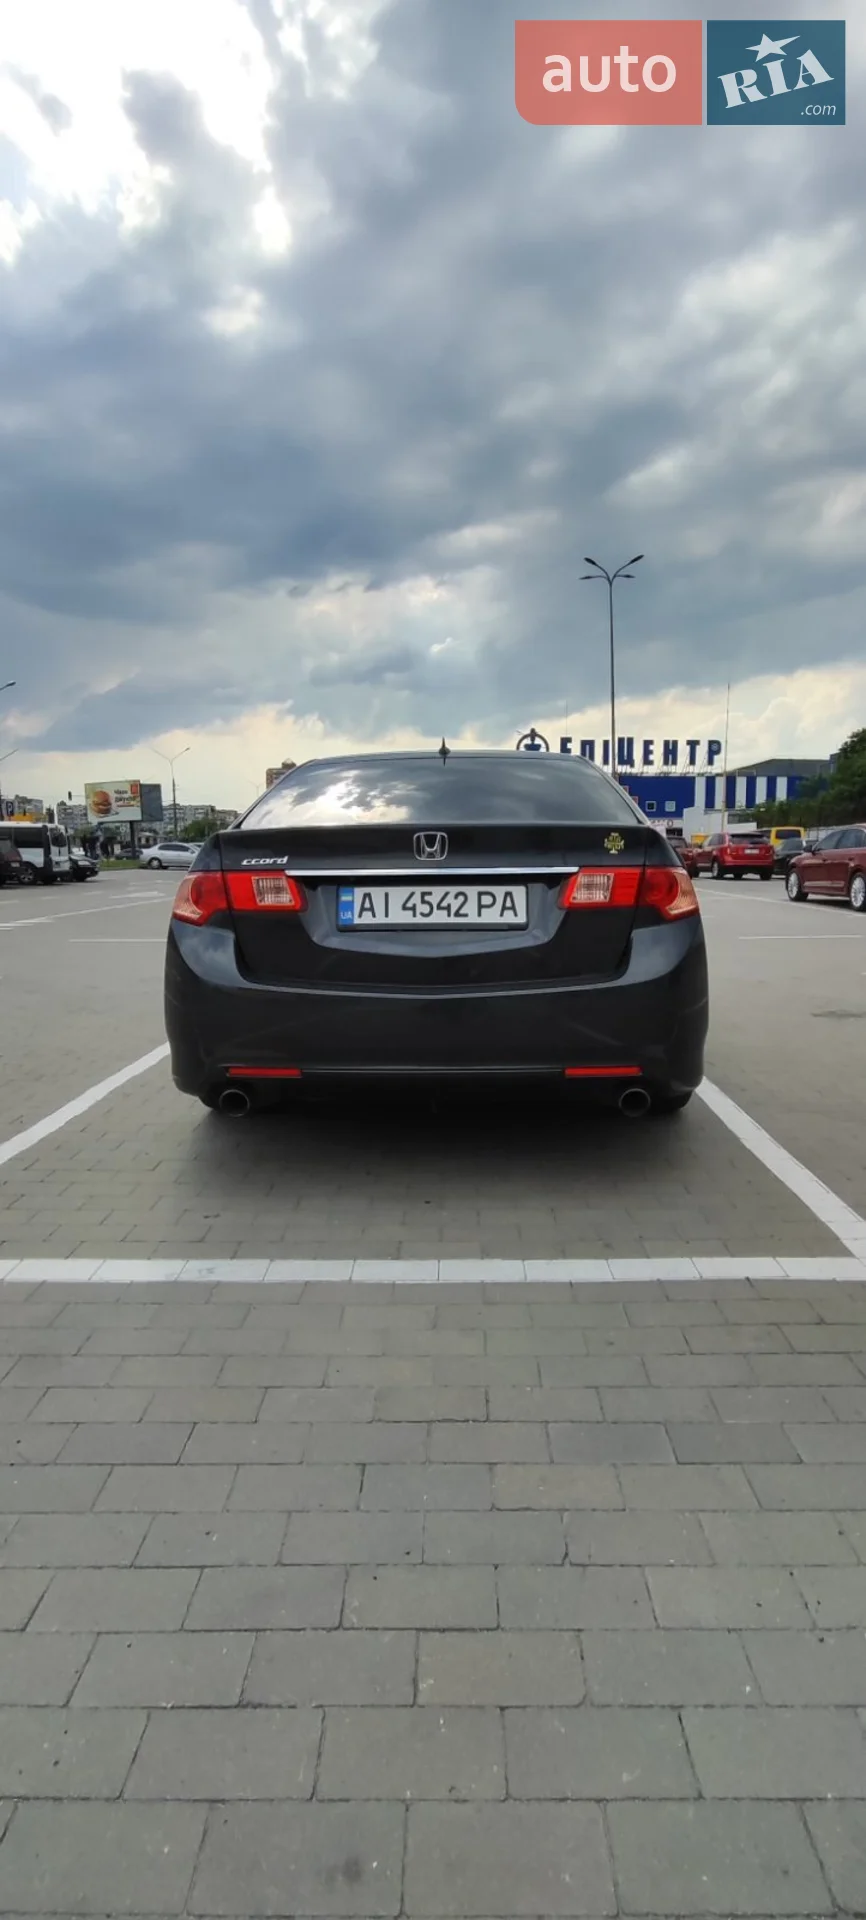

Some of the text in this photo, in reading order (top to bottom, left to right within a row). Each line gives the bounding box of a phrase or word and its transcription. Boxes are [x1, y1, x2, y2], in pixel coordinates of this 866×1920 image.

[560, 737, 721, 767] ЕПІЦЕНТР
[241, 855, 289, 866] ccord
[357, 890, 518, 919] AI 4542 PA
[340, 911, 353, 920] UA
